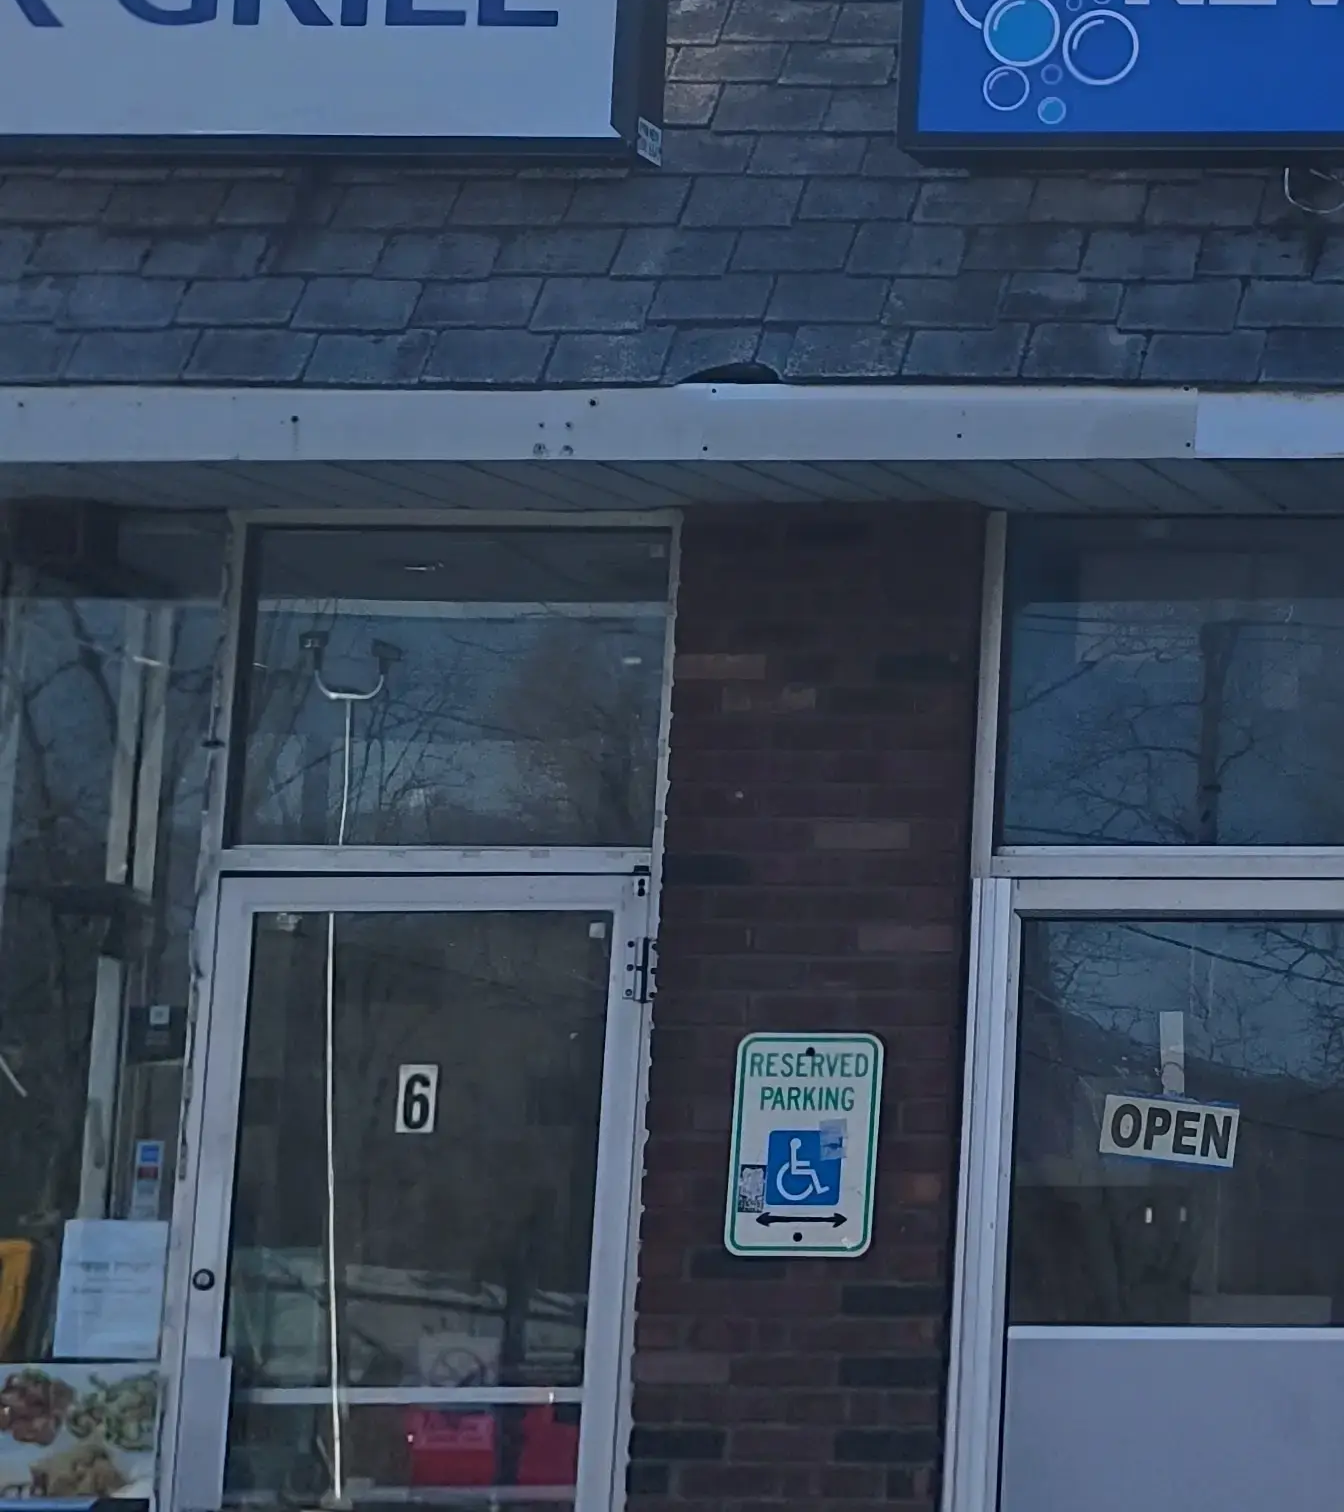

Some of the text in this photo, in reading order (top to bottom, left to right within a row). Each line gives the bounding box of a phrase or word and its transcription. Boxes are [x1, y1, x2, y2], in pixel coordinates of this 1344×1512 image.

[749, 1052, 870, 1078] RESERVED
[403, 1073, 431, 1130] 6
[759, 1086, 856, 1112] PARKING
[1110, 1103, 1233, 1160] OPEN
